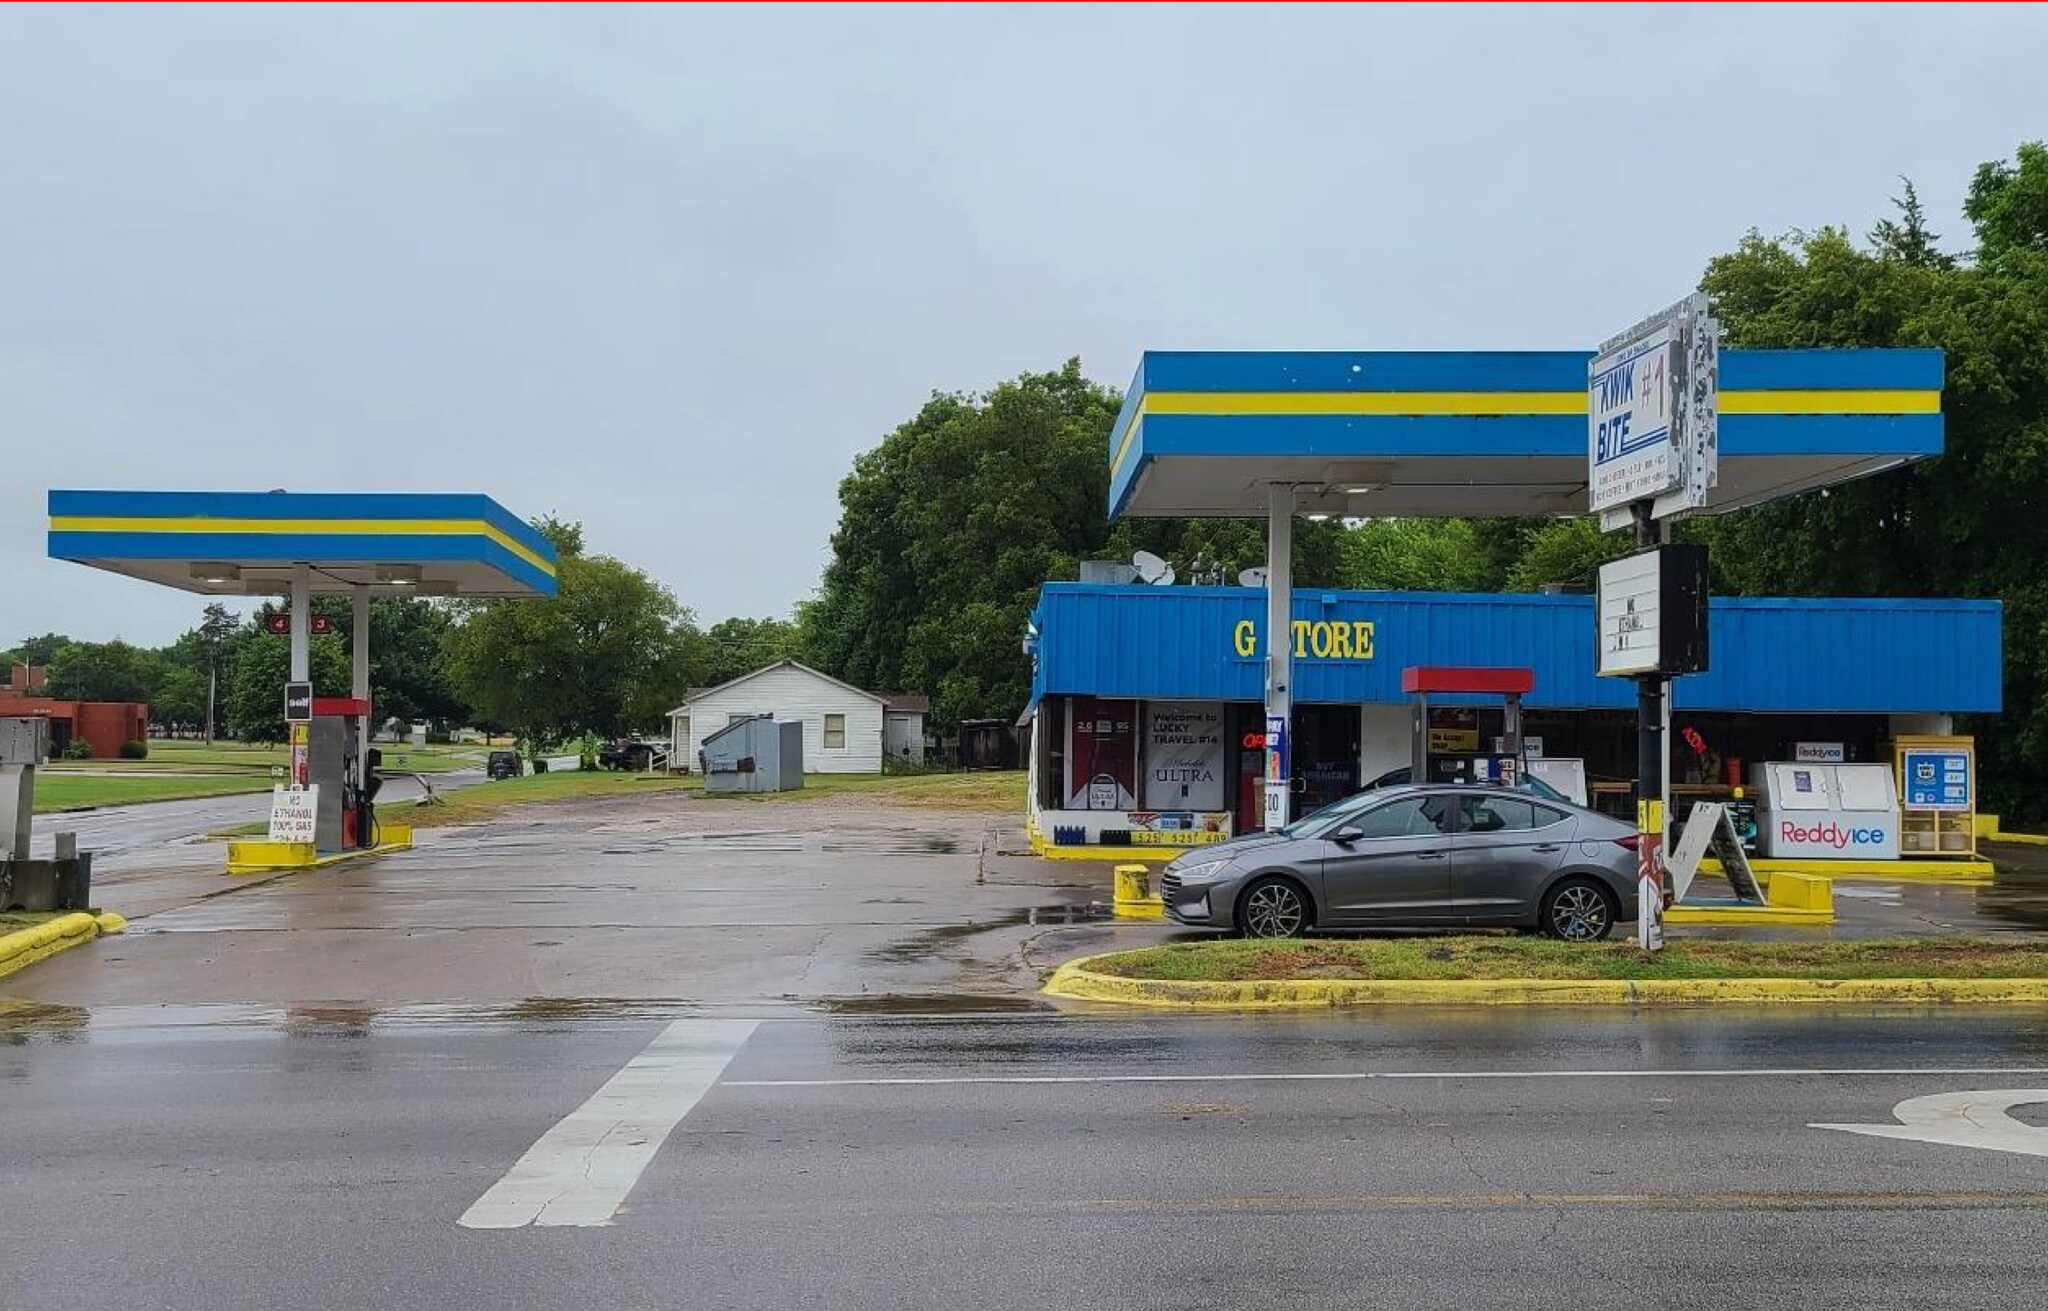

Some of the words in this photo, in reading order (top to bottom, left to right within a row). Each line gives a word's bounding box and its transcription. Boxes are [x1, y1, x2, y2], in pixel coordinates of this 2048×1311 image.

[1601, 361, 1634, 414] KWIK
[1598, 412, 1632, 462] BITE
[275, 618, 284, 628] 4
[316, 618, 325, 629] 3
[1234, 620, 1256, 657] G
[1153, 711, 1202, 722] Welcome
[1205, 712, 1217, 722] to
[1153, 723, 1189, 733] LUCKY
[1153, 735, 1197, 744] TRAVEL
[1156, 769, 1214, 782] ULTRA
